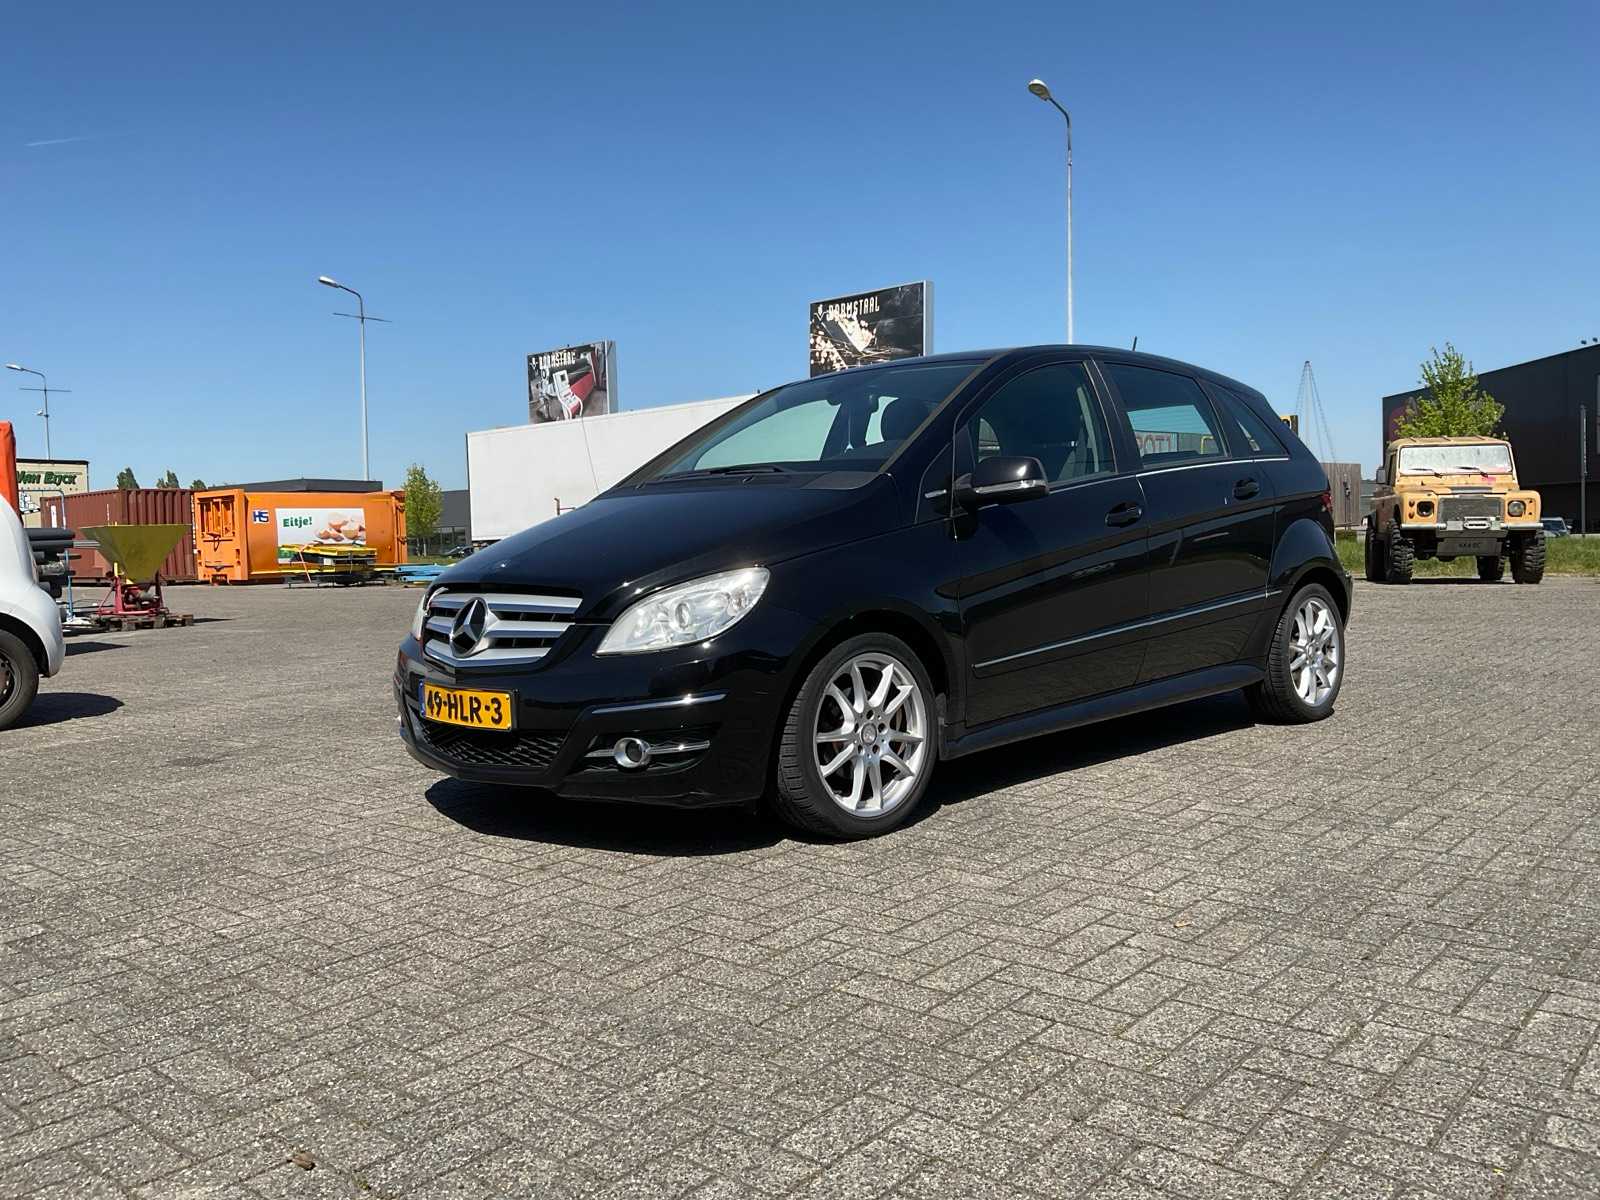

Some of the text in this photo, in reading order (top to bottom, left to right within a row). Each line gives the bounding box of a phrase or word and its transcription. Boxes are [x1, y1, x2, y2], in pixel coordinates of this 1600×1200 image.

[253, 510, 269, 523] HS
[283, 516, 312, 529] Eitje!
[427, 690, 503, 725] 49-HLR-3
